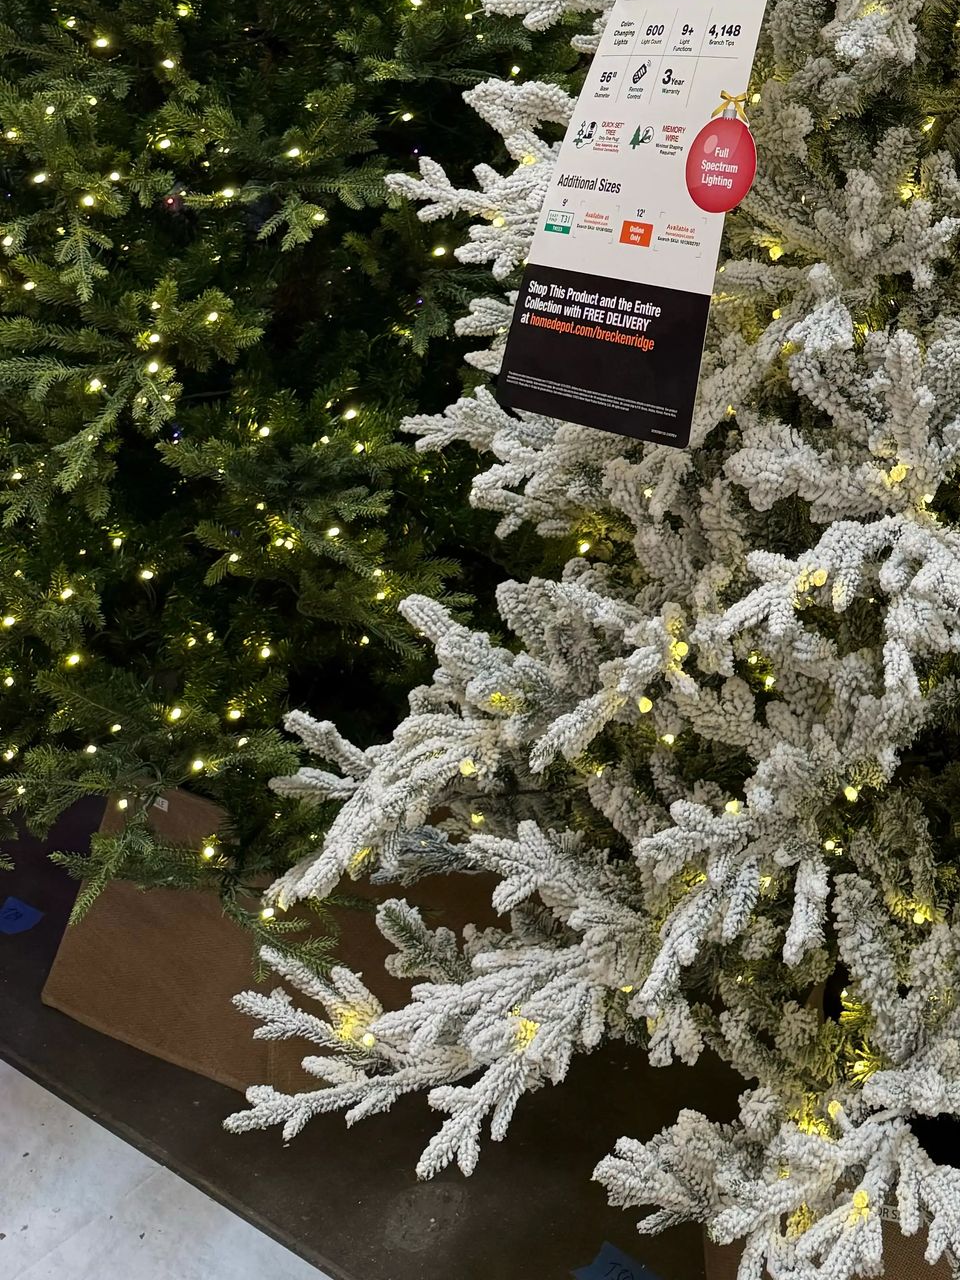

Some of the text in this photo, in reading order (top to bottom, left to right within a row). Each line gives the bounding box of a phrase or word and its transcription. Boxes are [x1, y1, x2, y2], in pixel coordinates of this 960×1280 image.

[613, 30, 635, 38] Changing
[646, 24, 741, 39] 600 9+ 4,148
[662, 68, 673, 85] 3
[671, 78, 685, 86] Year
[662, 125, 686, 133] MEMORY
[665, 134, 680, 142] WIRE
[669, 143, 683, 151] Shaping
[714, 146, 729, 158] Full
[700, 159, 738, 174] Spectrum
[557, 174, 622, 194] Additional Sizes
[701, 173, 733, 189] Lighting
[585, 211, 604, 220] Available
[636, 208, 646, 218] 12'
[629, 225, 645, 234] Online
[666, 224, 689, 233] Available
[629, 233, 641, 243] Only
[528, 280, 661, 318] Shop This Product and the Entire
[524, 295, 562, 315] Collection
[563, 304, 582, 319] with
[582, 307, 606, 323] FREE
[520, 312, 655, 352] at homedepot.com/breckenridge
